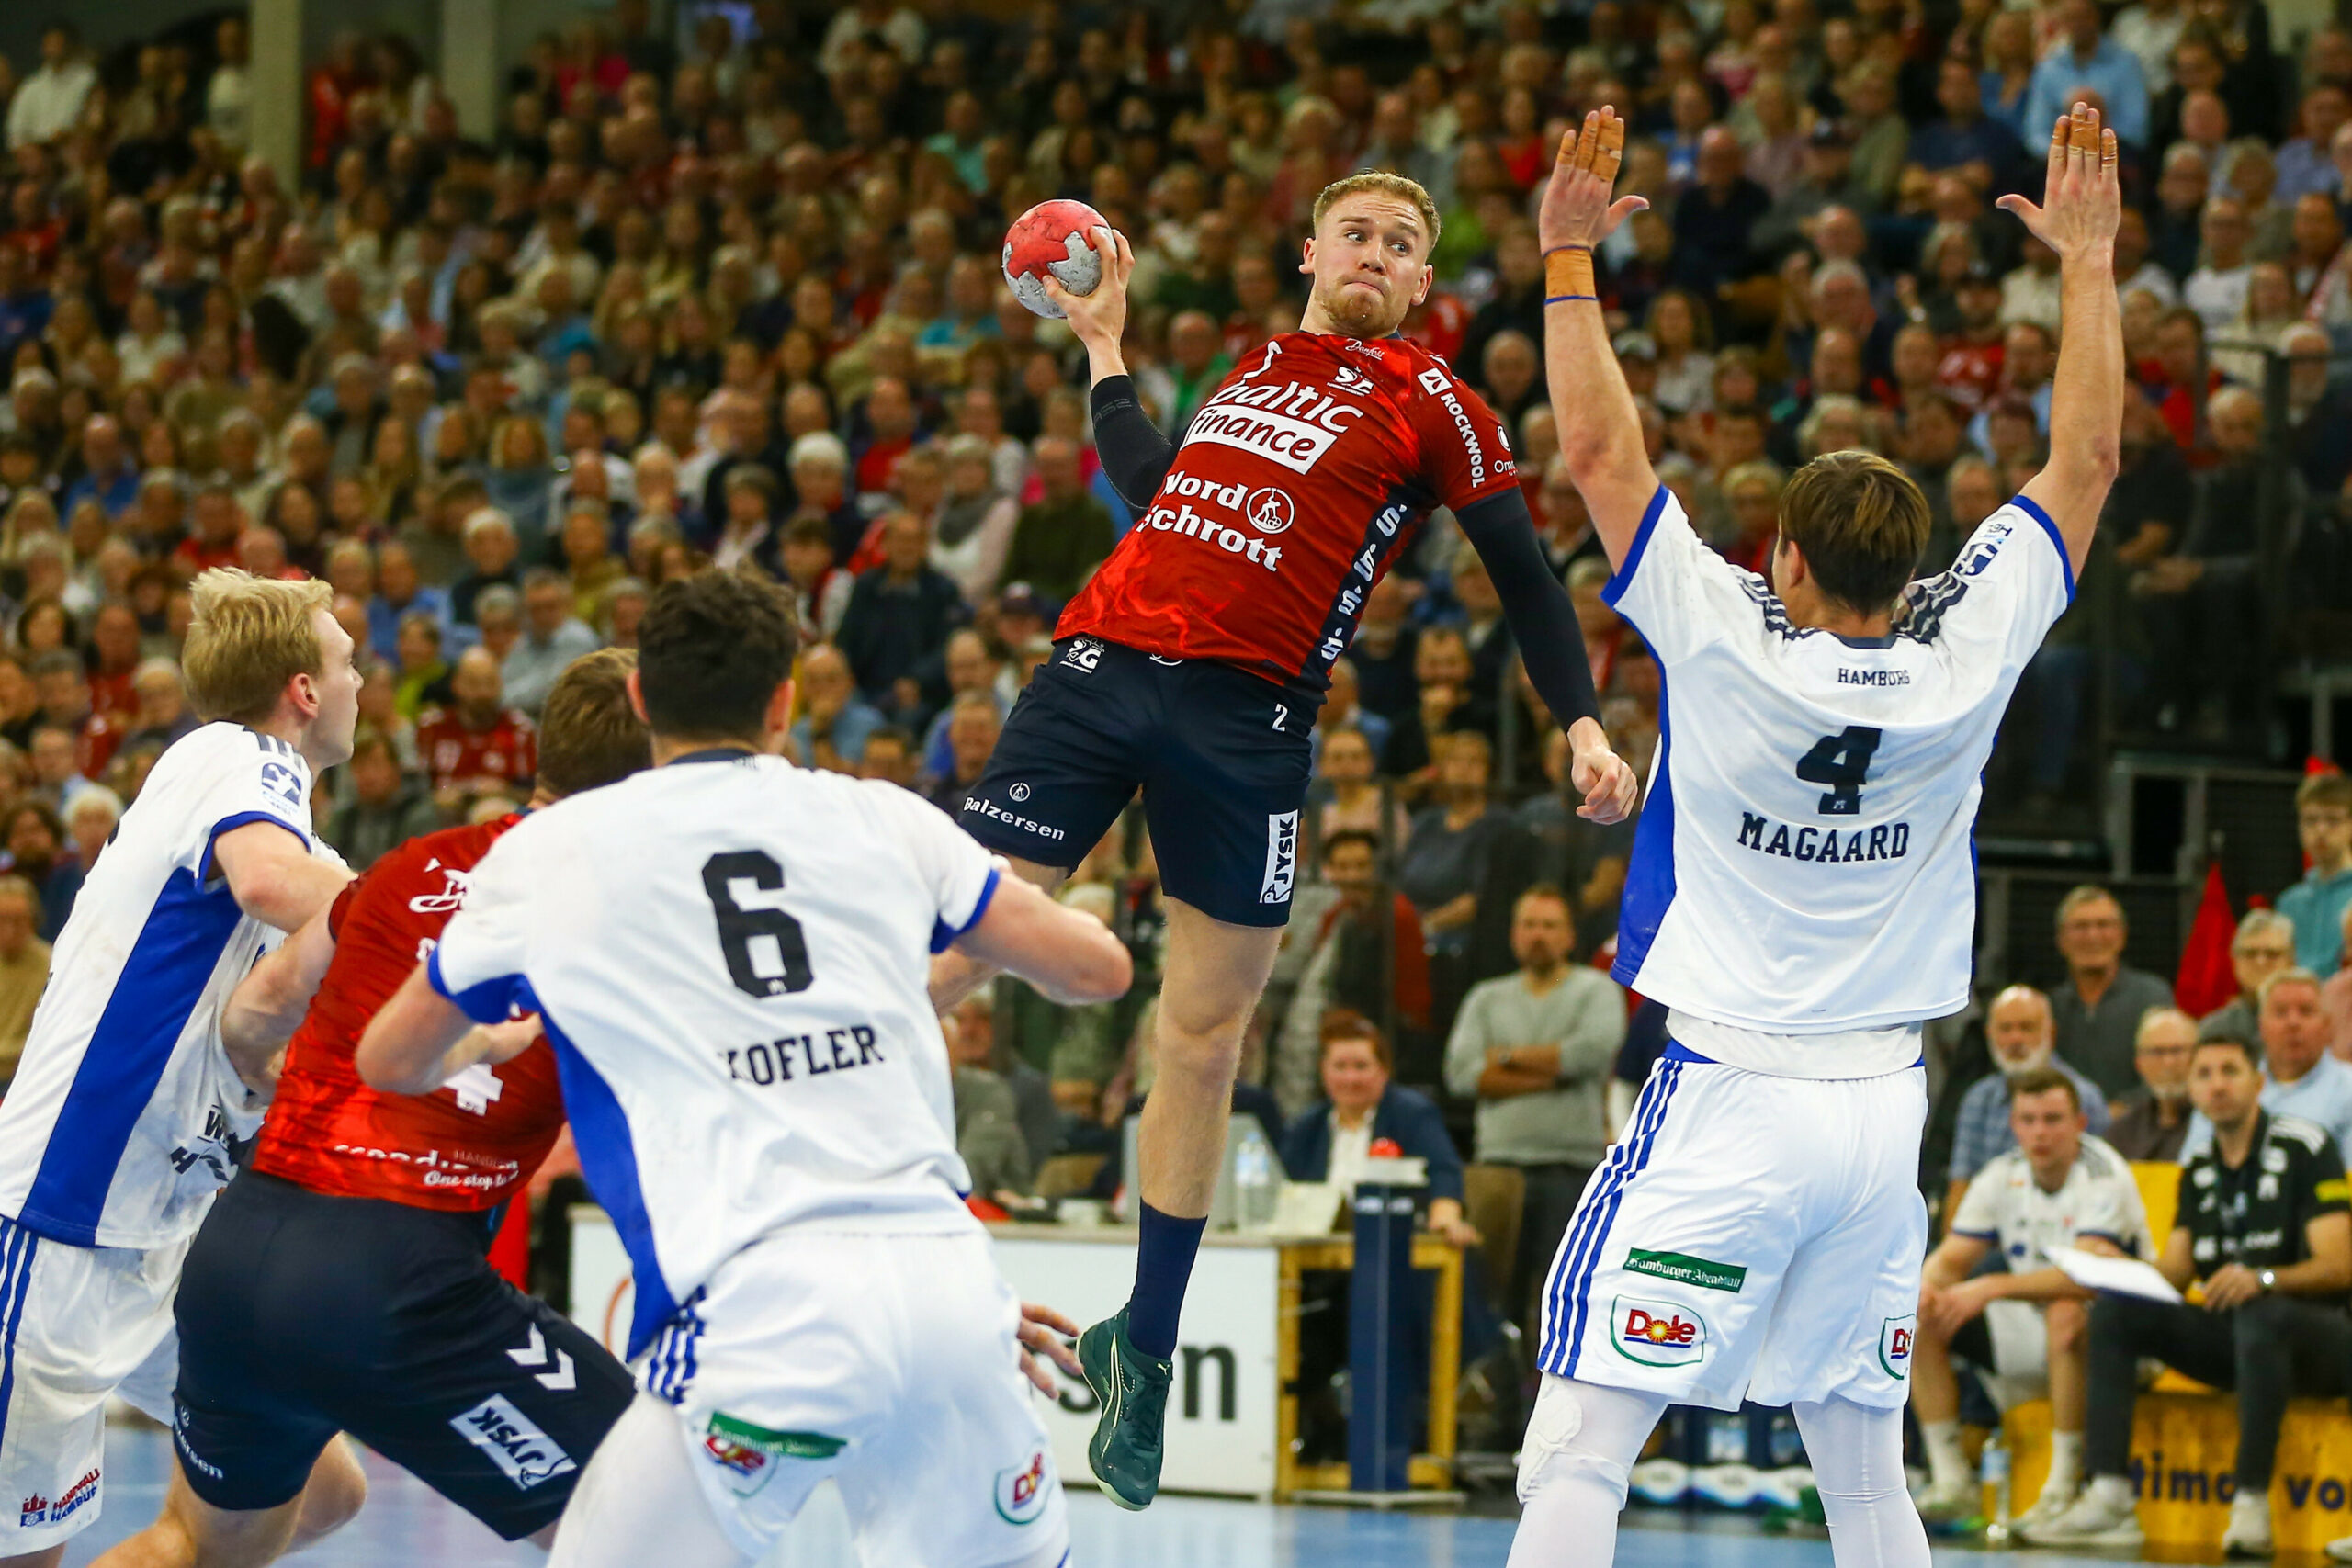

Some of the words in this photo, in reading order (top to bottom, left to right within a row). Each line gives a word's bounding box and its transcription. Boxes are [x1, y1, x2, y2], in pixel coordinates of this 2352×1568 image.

[1440, 392, 1485, 488] ROCKWOOL
[1838, 668, 1910, 686] HAMBURG
[1272, 703, 1288, 732] 2
[1796, 725, 1883, 815] 4
[964, 797, 1065, 840] Balzersen
[1737, 811, 1910, 863] MAGAARD
[1274, 816, 1295, 885] JYSK
[702, 850, 814, 999] 6
[1625, 1309, 1696, 1344] Dole
[468, 1406, 546, 1464] JYSK
[51, 1486, 97, 1522] HAMBUR
[2286, 1475, 2352, 1511] vo
